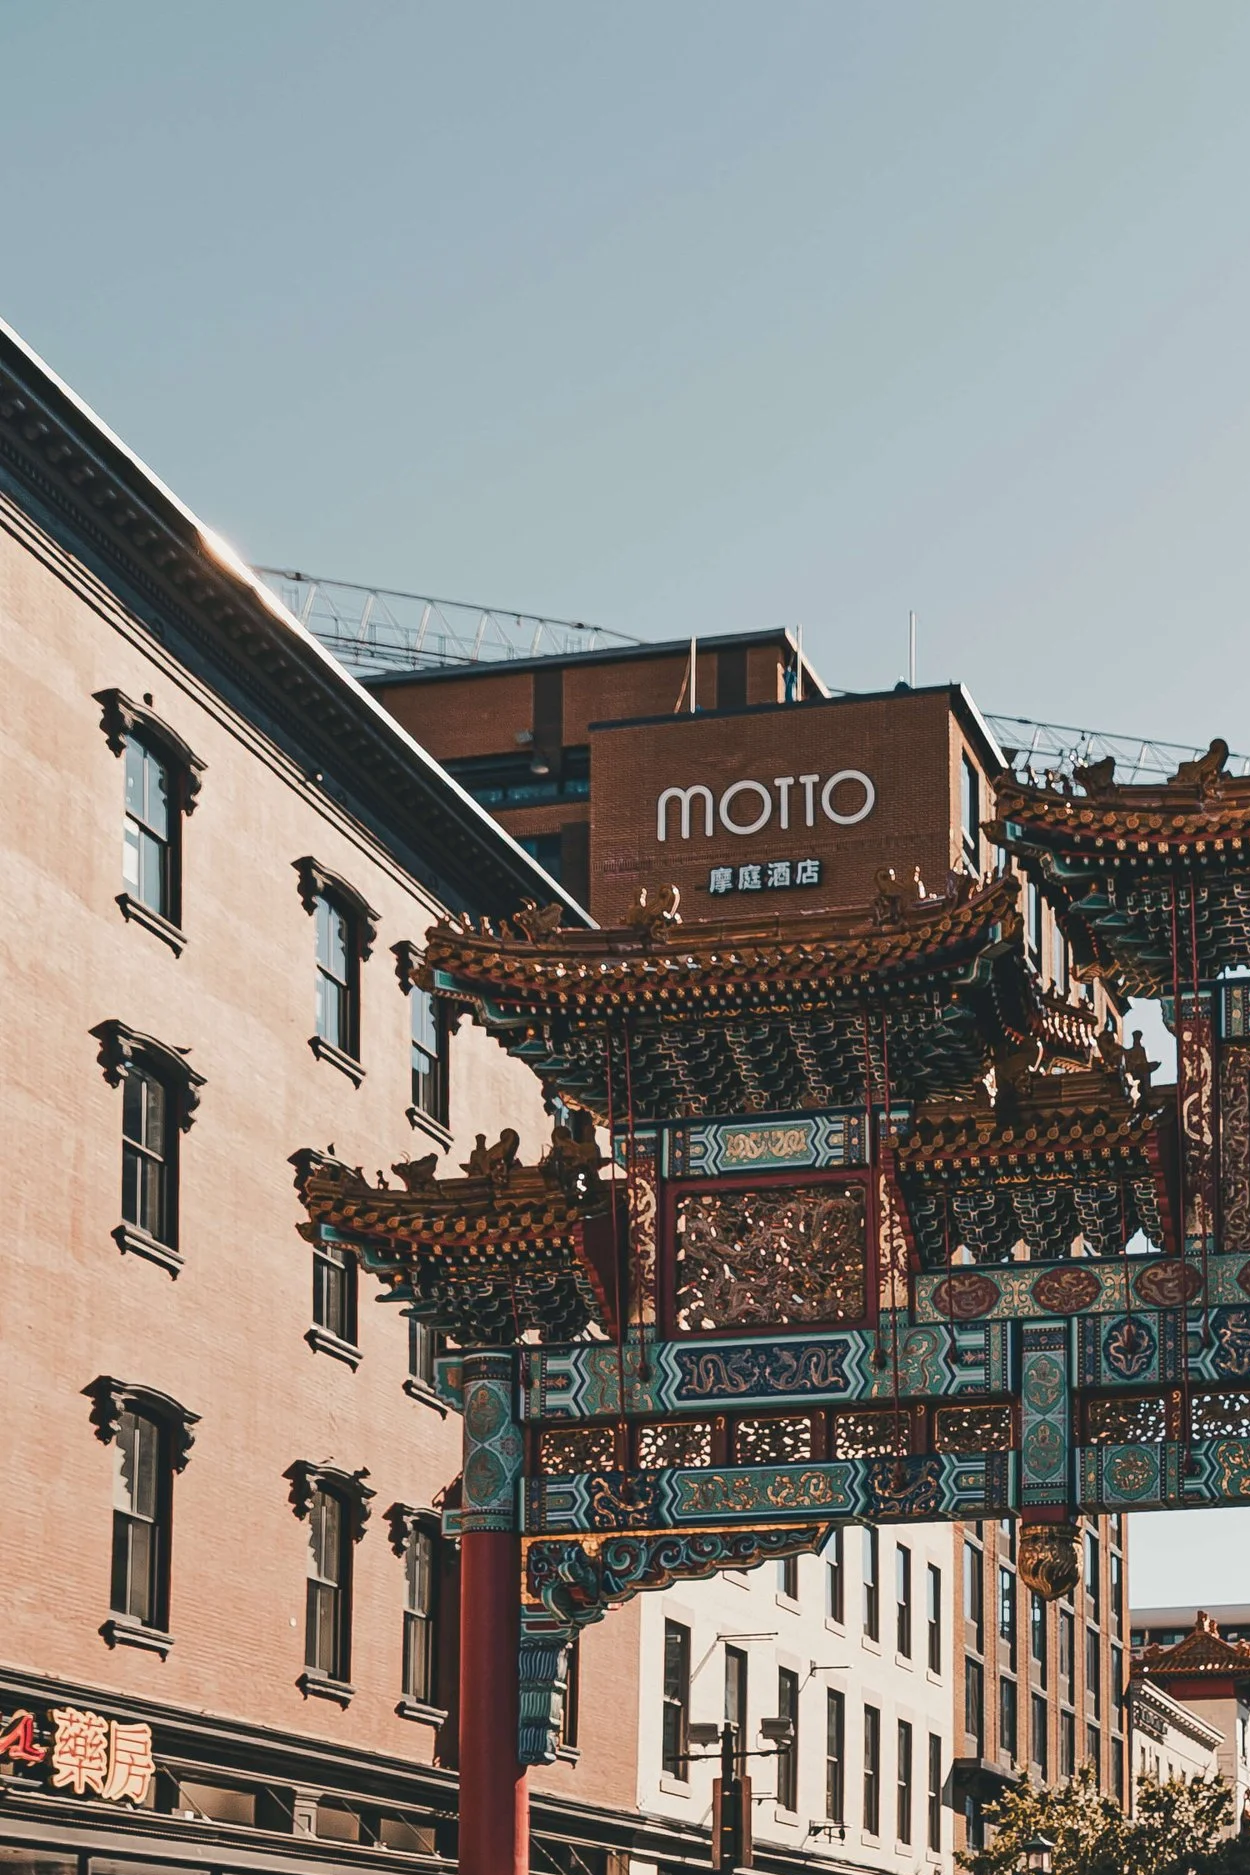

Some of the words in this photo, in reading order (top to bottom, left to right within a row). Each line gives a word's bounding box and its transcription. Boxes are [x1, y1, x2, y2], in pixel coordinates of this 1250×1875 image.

[709, 858, 821, 894] 摩庭酒店
[52, 1707, 156, 1804] 藥房
